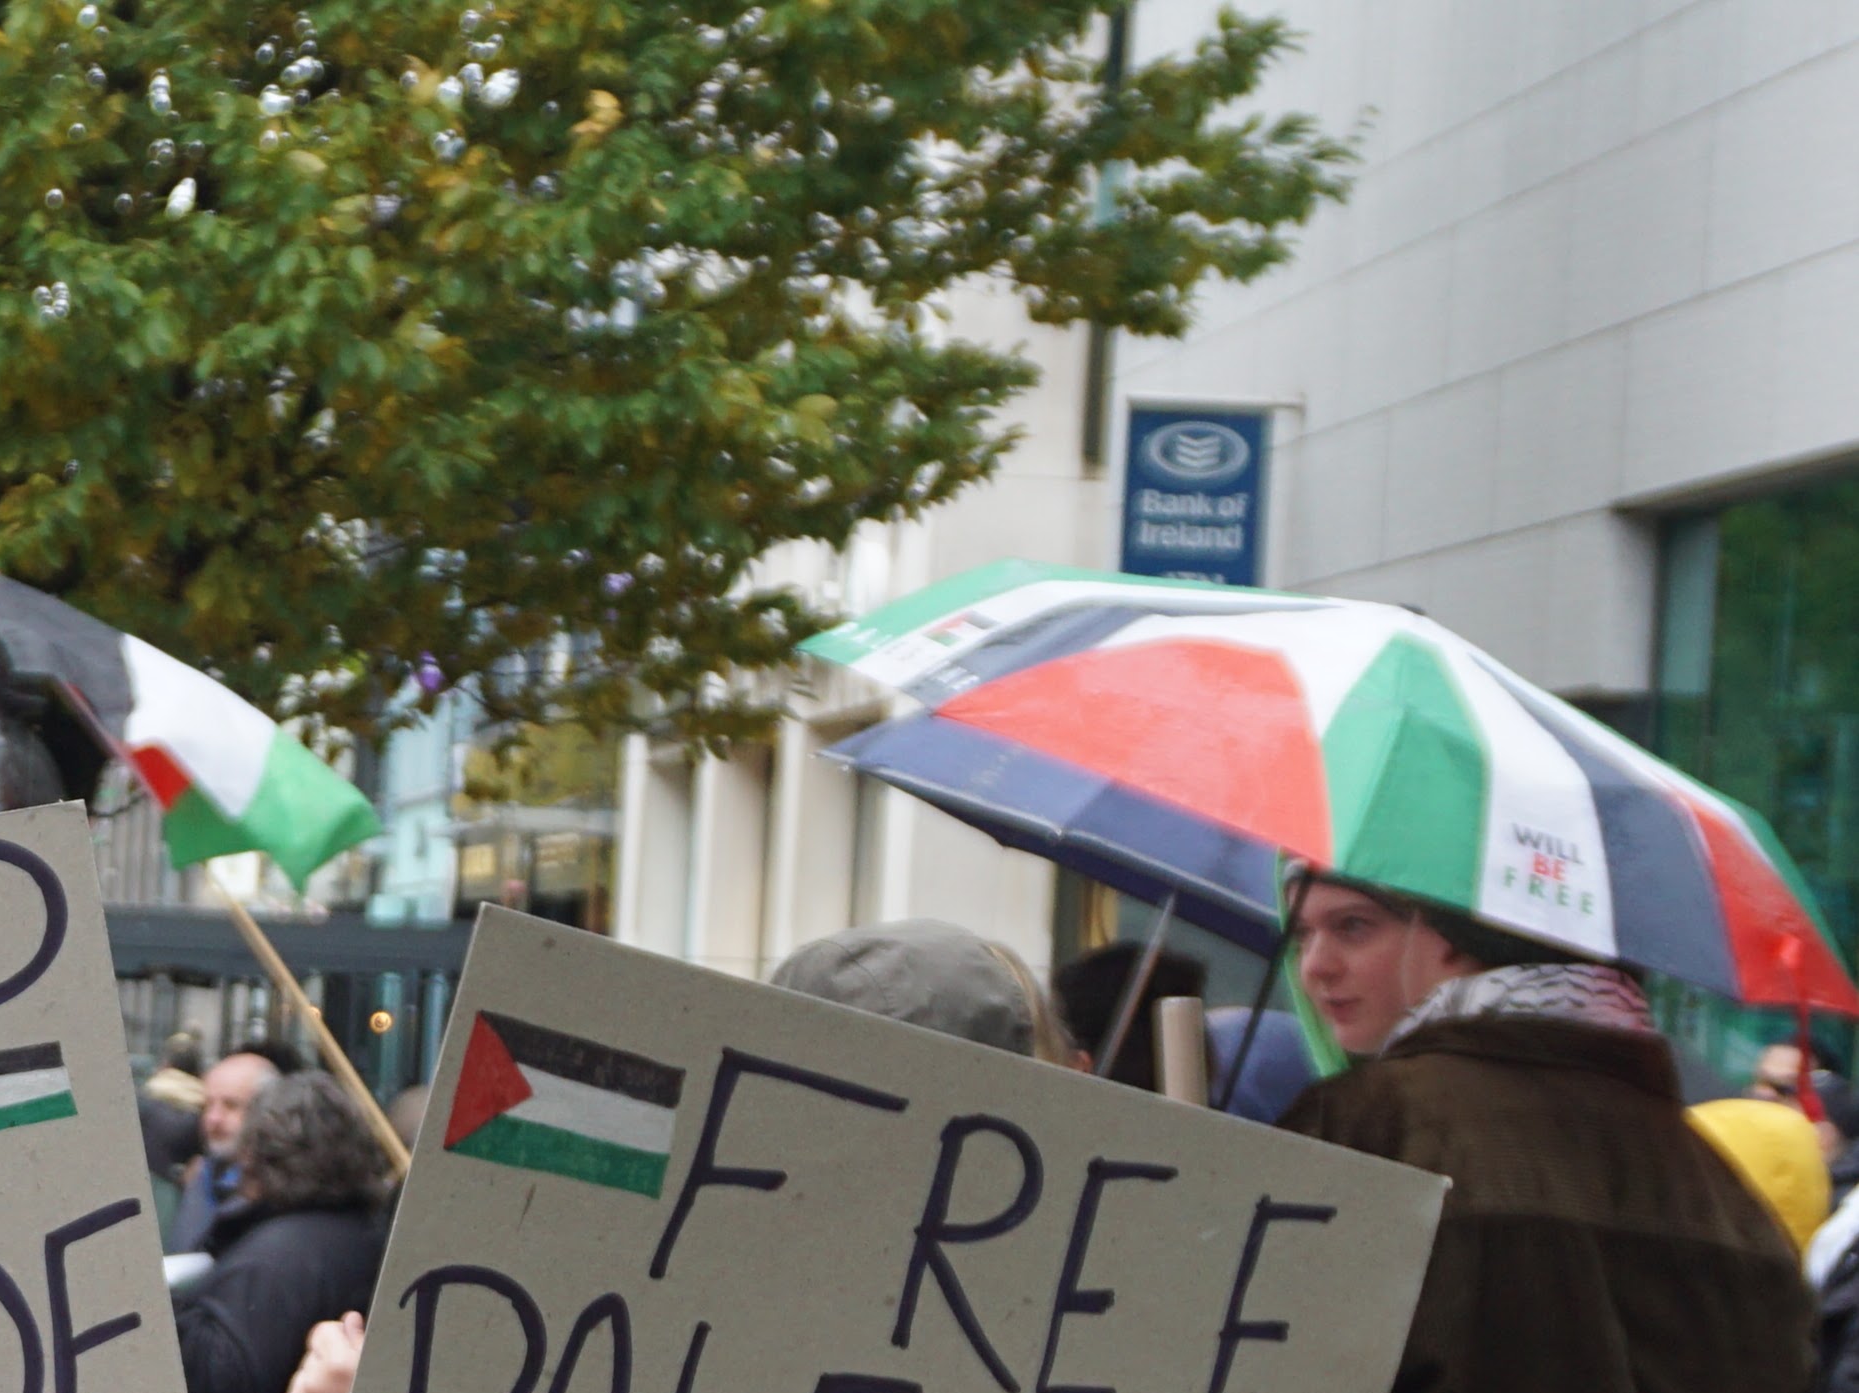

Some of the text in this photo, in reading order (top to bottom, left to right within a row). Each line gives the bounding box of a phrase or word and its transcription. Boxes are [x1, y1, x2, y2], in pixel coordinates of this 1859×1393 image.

[1142, 488, 1249, 518] Bank of
[1137, 521, 1243, 550] Ireland
[1511, 822, 1584, 866] WILL
[1532, 850, 1565, 882] BE
[1502, 864, 1595, 916] FREE
